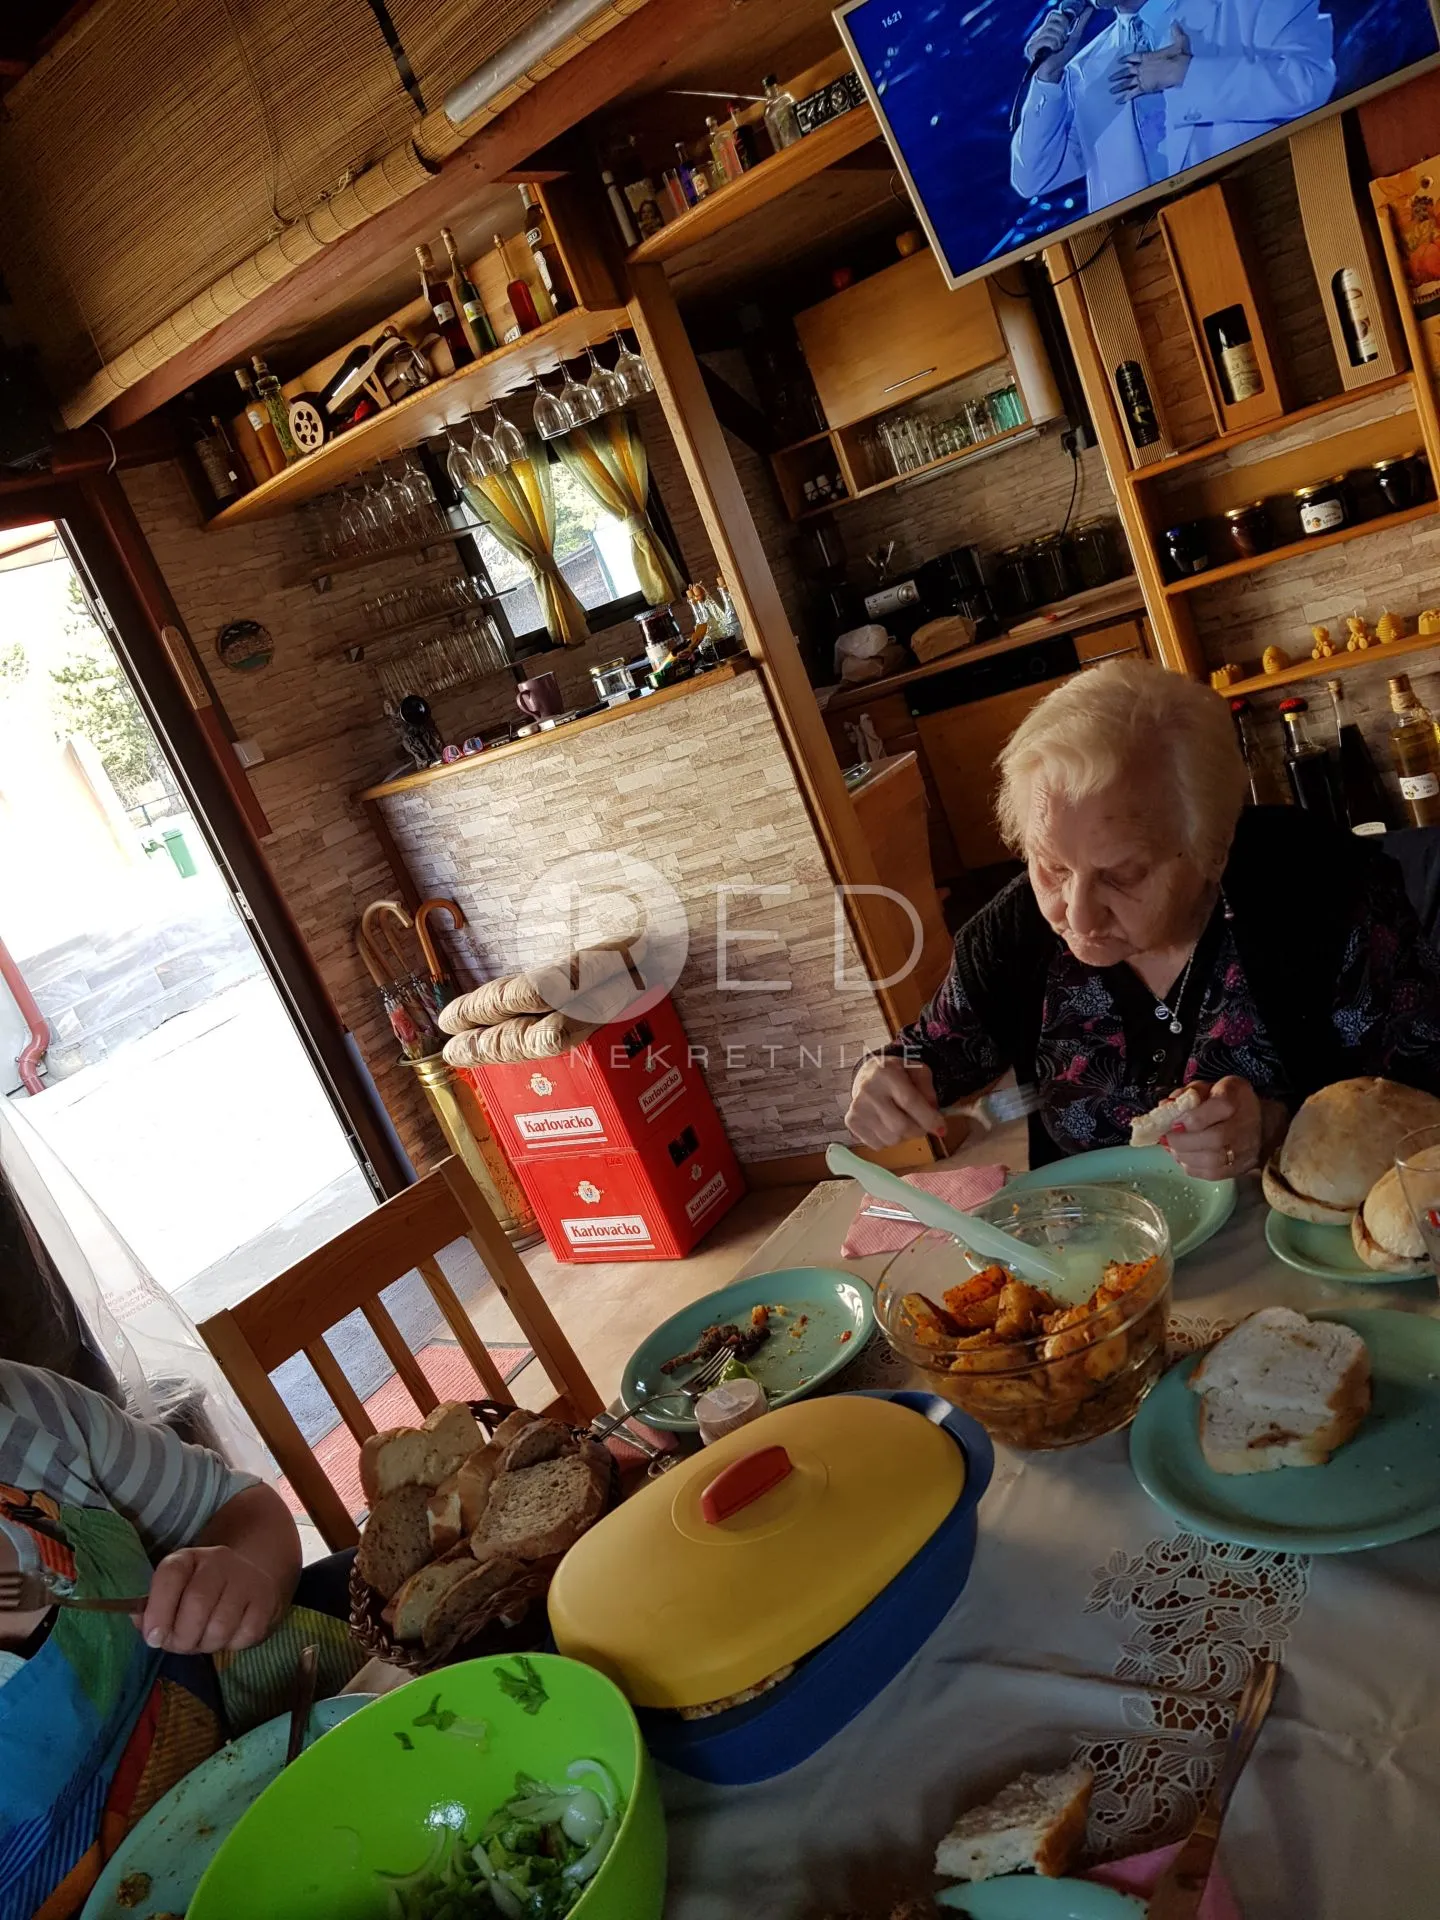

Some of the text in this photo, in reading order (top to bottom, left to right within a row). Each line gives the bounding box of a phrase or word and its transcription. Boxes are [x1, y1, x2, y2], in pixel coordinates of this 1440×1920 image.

[642, 1072, 679, 1107] Karlovačko
[524, 1115, 594, 1133] Karlovačko
[689, 1178, 723, 1215] Karlovačko
[570, 1222, 641, 1238] Karlovačko
